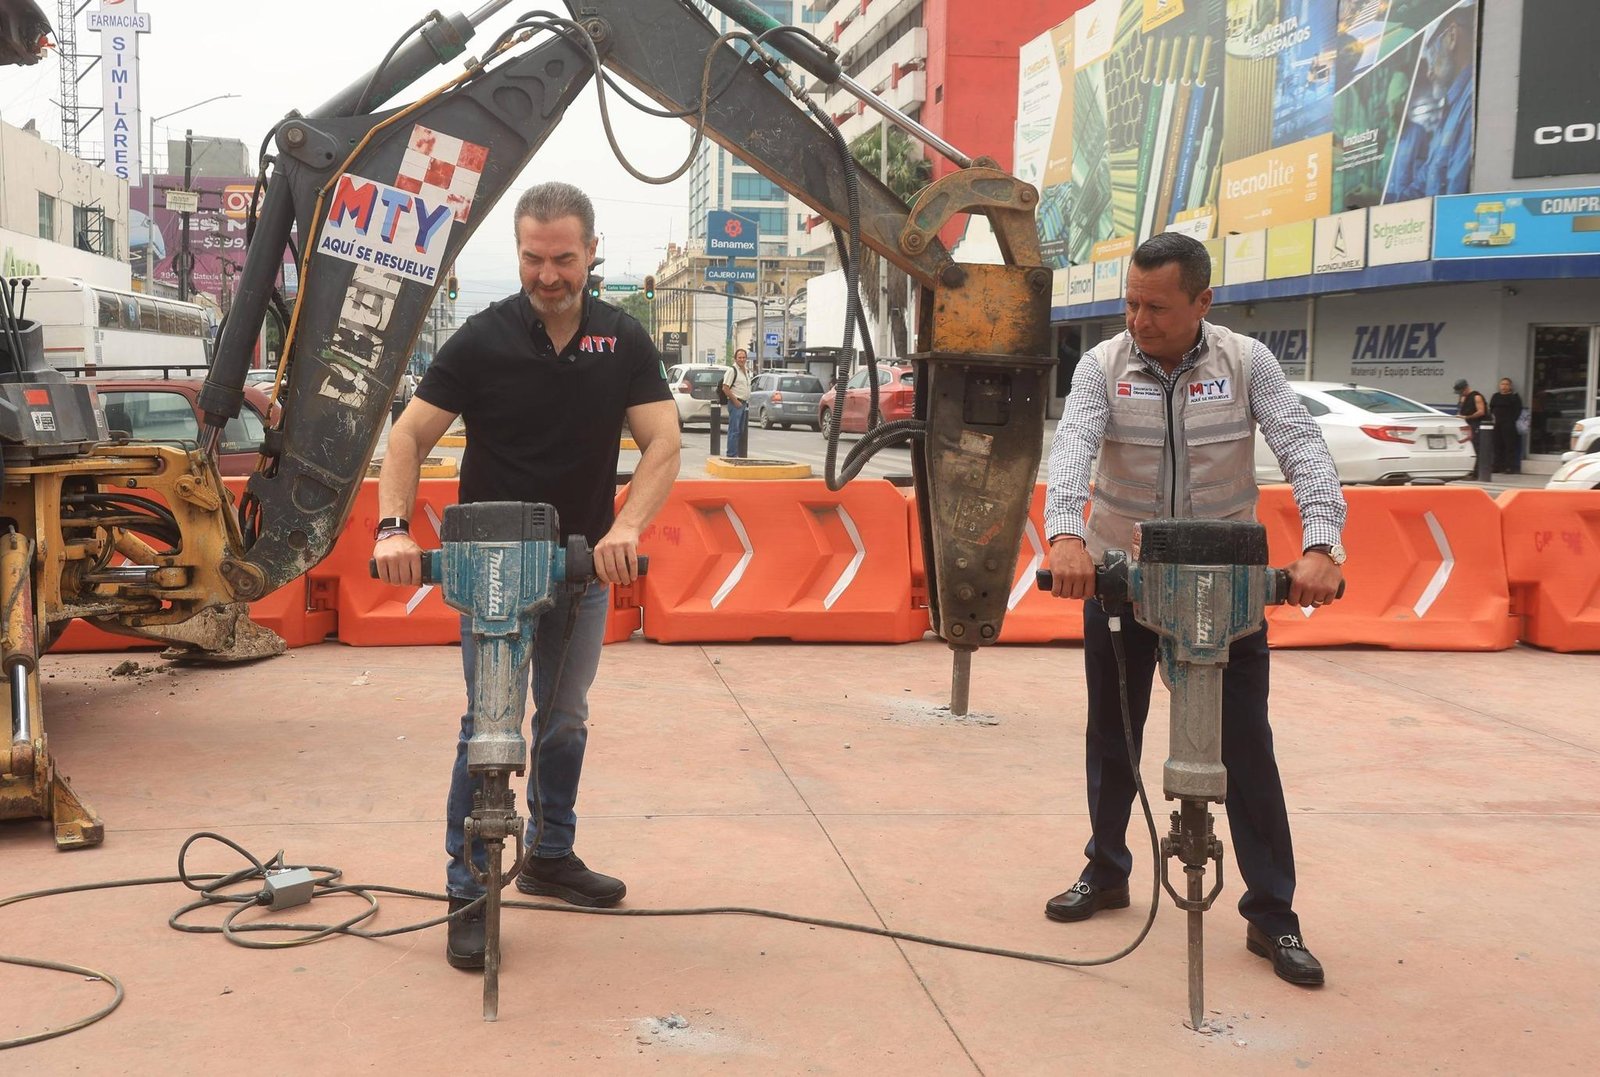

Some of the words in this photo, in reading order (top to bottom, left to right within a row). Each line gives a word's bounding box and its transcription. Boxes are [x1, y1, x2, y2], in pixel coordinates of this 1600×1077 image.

[91, 15, 145, 28] FARMACIAS
[111, 36, 129, 180] SIMILARES
[1534, 122, 1600, 145] CO
[1306, 153, 1319, 180] 5
[1226, 159, 1295, 199] tecnolite
[328, 175, 452, 254] MTY
[1373, 217, 1426, 239] Schneider
[711, 239, 755, 249] Banamex
[321, 236, 356, 256] AQUÍ
[356, 245, 373, 261] SE
[374, 251, 436, 280] RESUELVE
[1316, 259, 1361, 273] CONDUMEX
[708, 270, 736, 279] CAJERO
[1070, 276, 1091, 295] simon
[579, 335, 617, 353] MTY
[1249, 329, 1307, 360] AMEX
[1351, 322, 1447, 359] TAMEX
[1384, 366, 1409, 378] Equipo
[1189, 380, 1227, 397] MTY
